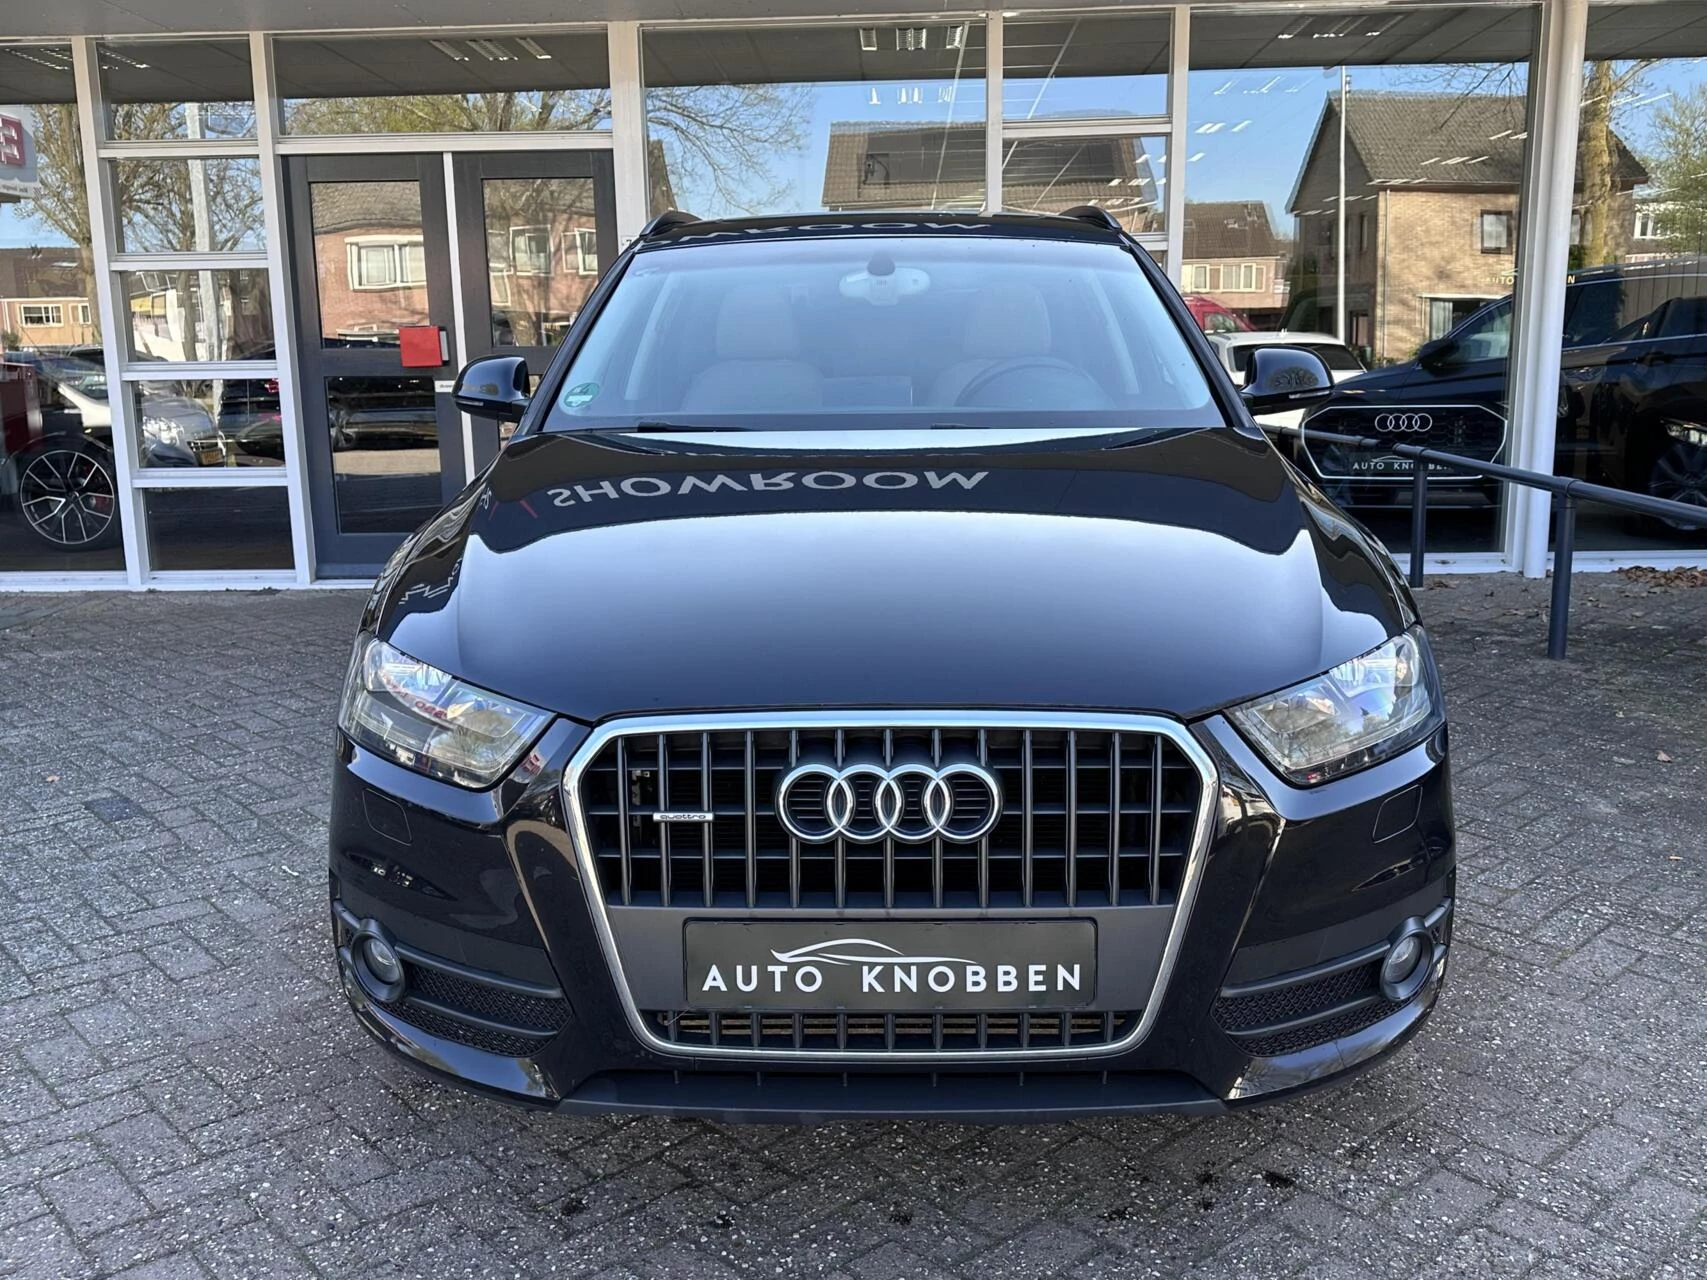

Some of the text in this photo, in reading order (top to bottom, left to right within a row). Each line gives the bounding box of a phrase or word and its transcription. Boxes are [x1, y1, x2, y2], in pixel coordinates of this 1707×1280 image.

[1352, 462, 1385, 470] AUTO
[659, 813, 706, 821] quattro
[701, 964, 1081, 993] AUTO KNOBBEN
